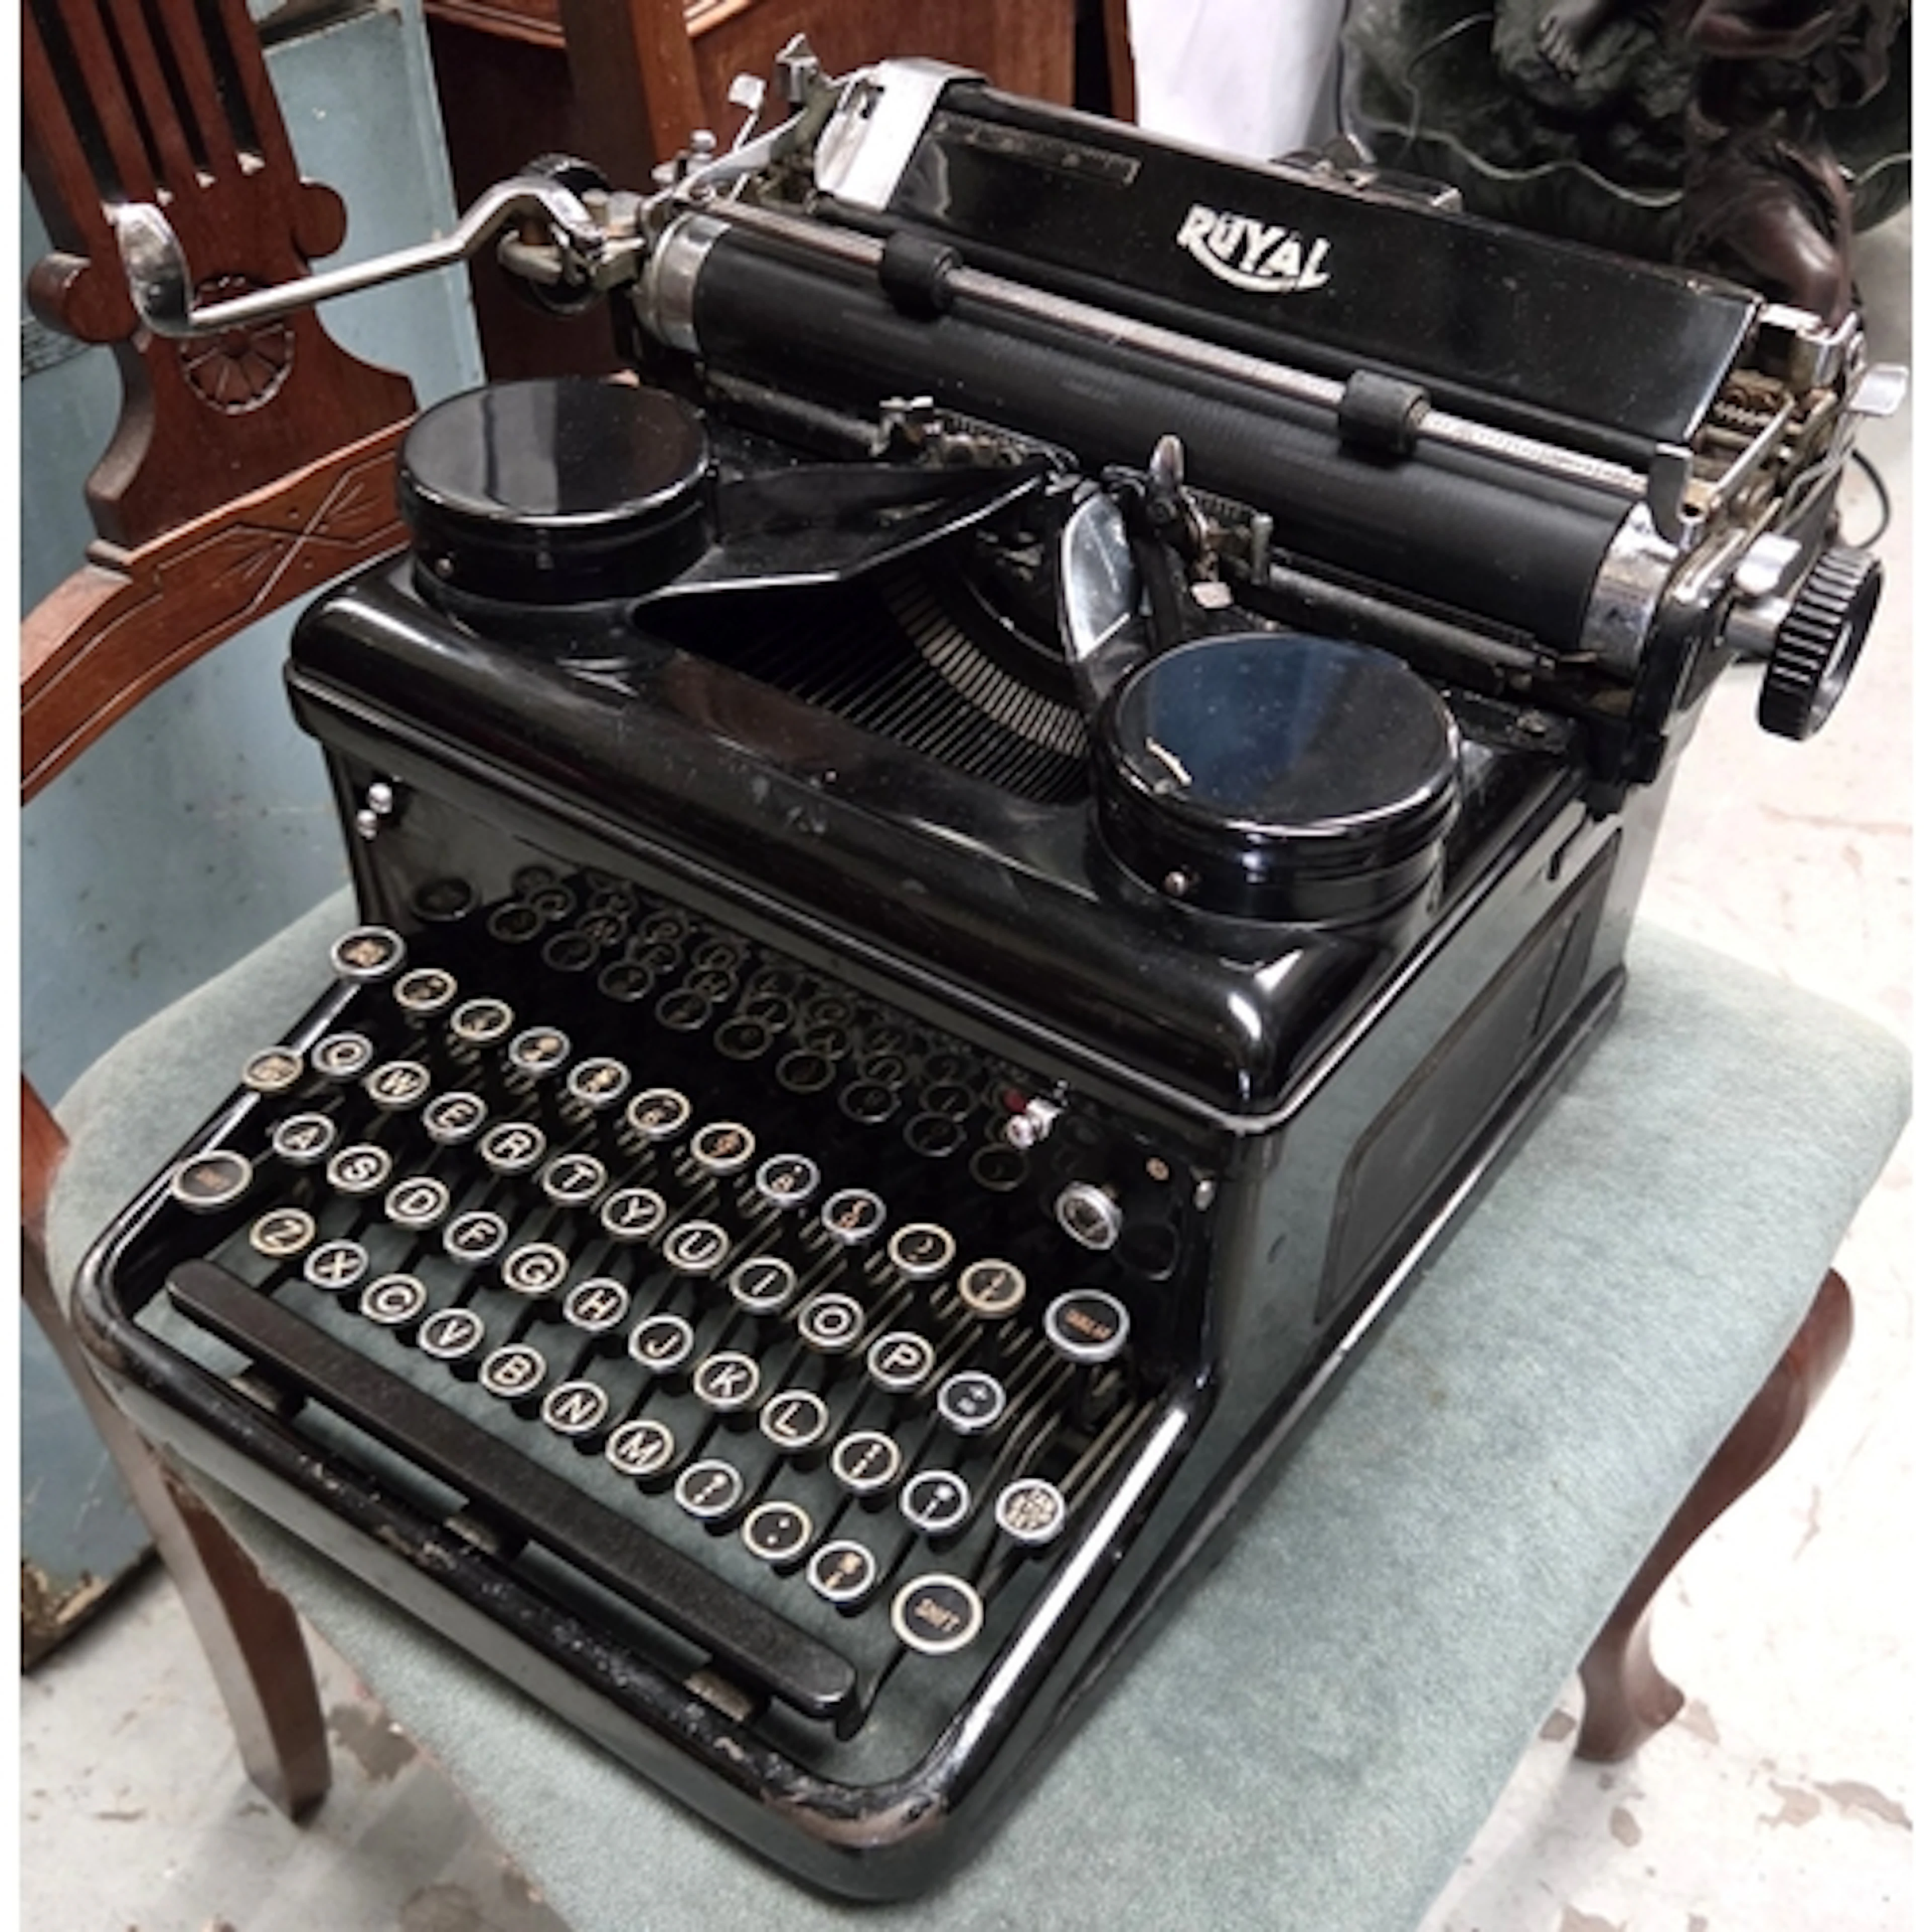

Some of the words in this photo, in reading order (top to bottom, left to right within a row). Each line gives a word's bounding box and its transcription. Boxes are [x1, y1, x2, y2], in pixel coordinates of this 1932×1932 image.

[1176, 203, 1331, 292] ROYAL
[438, 1101, 474, 1127] E
[494, 1131, 532, 1160] R
[342, 1157, 377, 1181] S
[562, 1163, 596, 1190] T
[399, 1188, 438, 1215] D
[620, 1196, 655, 1227] Y
[263, 1218, 302, 1248] Z
[457, 1219, 498, 1245] F
[679, 1231, 718, 1261] U
[316, 1249, 360, 1281] X
[519, 1255, 555, 1284] G
[376, 1285, 413, 1315] C
[577, 1289, 618, 1319] H
[437, 1319, 473, 1347] V
[813, 1306, 851, 1337] O
[492, 1353, 532, 1386] B
[882, 1343, 921, 1371] P
[708, 1362, 747, 1397] K
[554, 1391, 597, 1424] N
[618, 1429, 664, 1466] M
